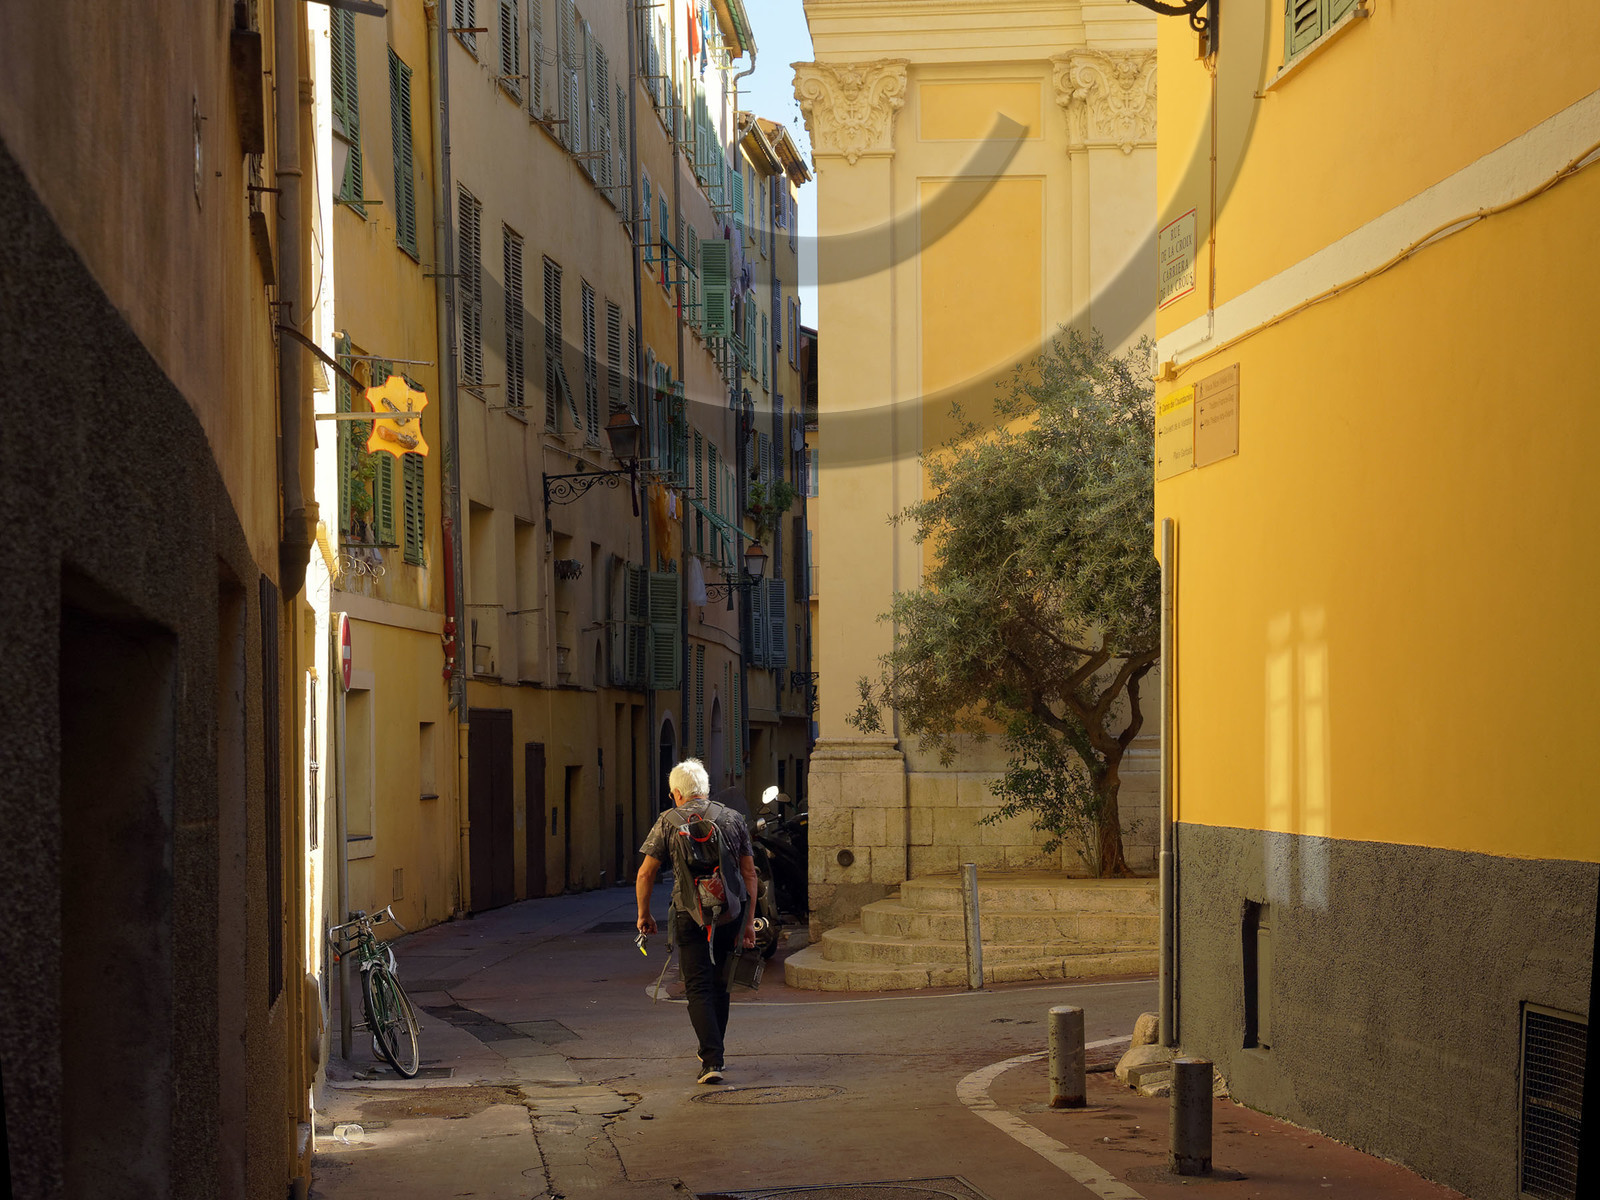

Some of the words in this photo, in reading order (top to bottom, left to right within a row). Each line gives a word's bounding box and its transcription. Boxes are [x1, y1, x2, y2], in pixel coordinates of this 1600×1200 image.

[1170, 224, 1181, 241] RUE
[1161, 249, 1167, 263] DE
[1168, 246, 1174, 258] LA
[1175, 233, 1193, 253] CROIX
[1162, 258, 1189, 283] CARRIERA
[1160, 288, 1166, 301] DE
[1167, 284, 1174, 296] LA
